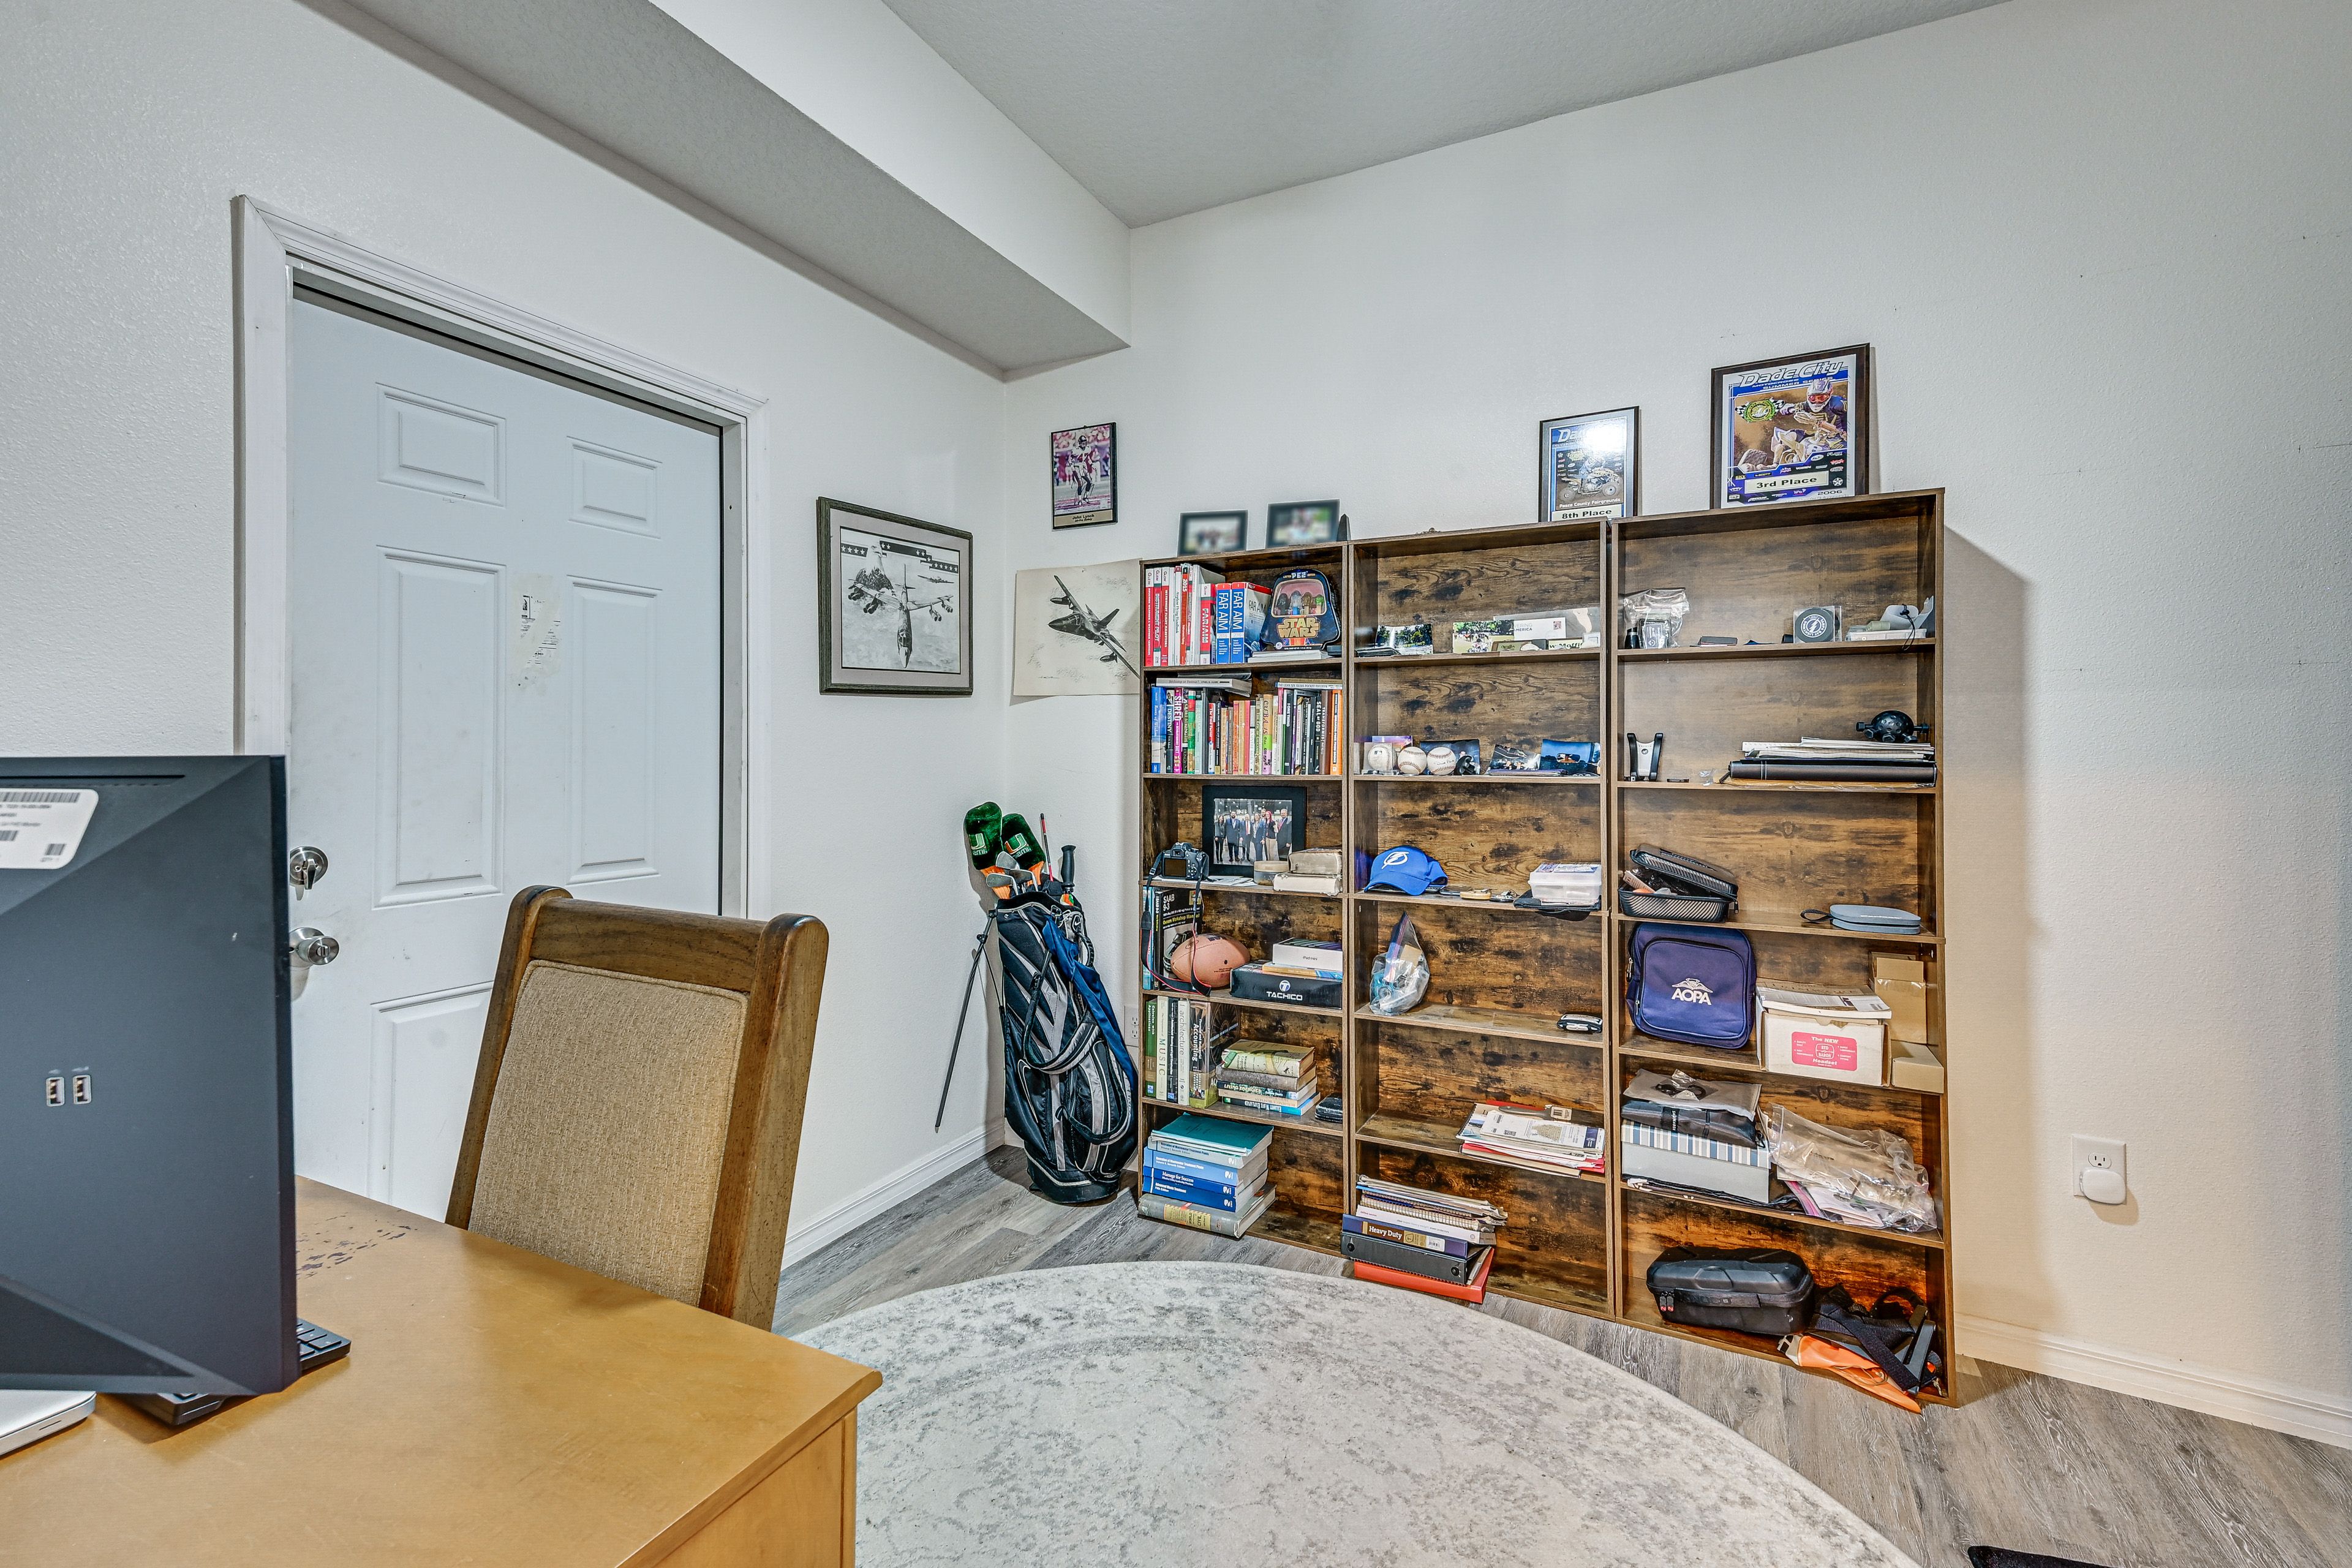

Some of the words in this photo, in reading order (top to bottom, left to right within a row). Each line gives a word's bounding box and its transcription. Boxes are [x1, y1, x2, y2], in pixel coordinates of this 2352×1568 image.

[1738, 368, 1794, 386] Dade
[1799, 361, 1844, 378] City
[1752, 379, 1799, 388] MOTOCROSS
[1781, 477, 1817, 486] Place
[1291, 572, 1306, 581] PEZ
[1218, 592, 1229, 609] FAR
[1233, 591, 1243, 608] FAR
[1218, 611, 1229, 631] AIM
[1232, 610, 1243, 630] AIM
[1278, 617, 1319, 628] STAR
[1278, 627, 1320, 638] WARS
[1163, 894, 1175, 904] SAAB
[1266, 991, 1303, 1001] TACHICO
[1671, 988, 1712, 1006] AOPA
[1369, 1225, 1387, 1237] Heavy
[1387, 1229, 1403, 1240] Duty
